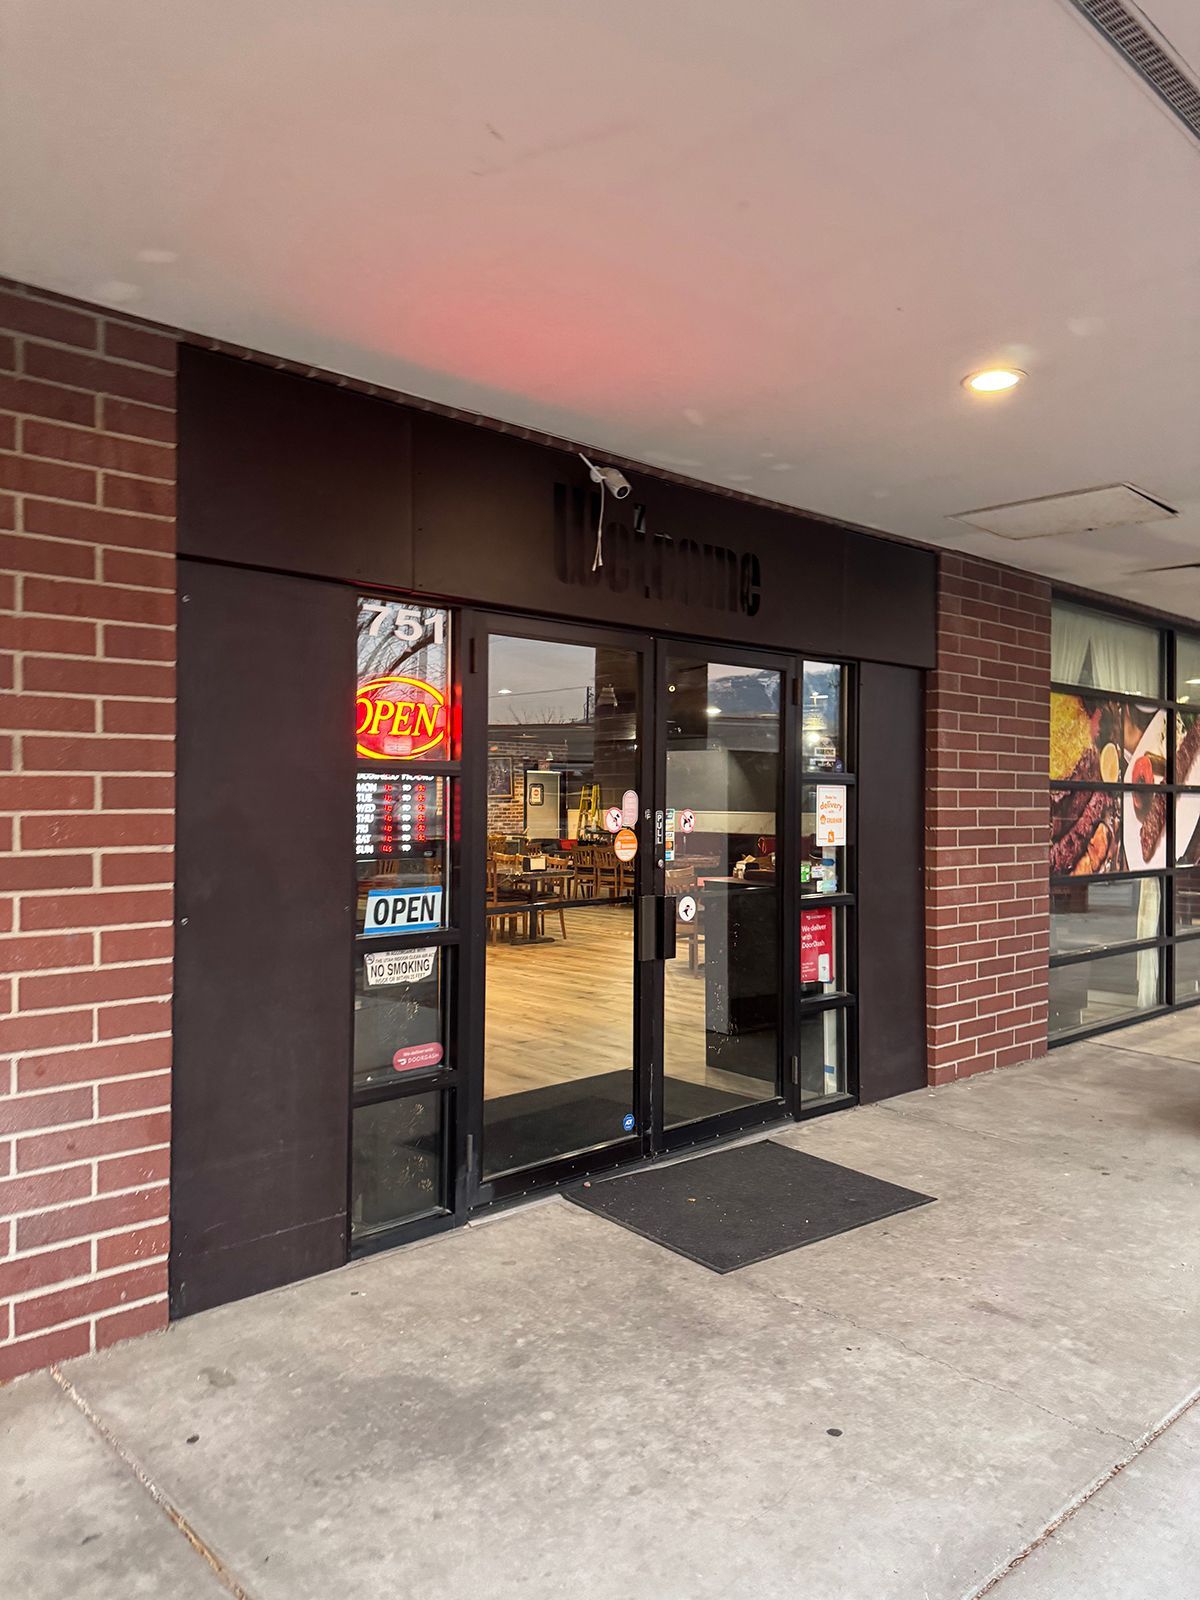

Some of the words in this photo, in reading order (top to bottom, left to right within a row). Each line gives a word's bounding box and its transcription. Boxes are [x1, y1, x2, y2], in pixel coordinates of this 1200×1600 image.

[362, 604, 444, 644] 751
[356, 699, 441, 737] OPEN
[356, 783, 377, 793] MON
[356, 793, 373, 803] TUE
[356, 803, 376, 813] WED
[820, 801, 843, 811] delivery
[356, 813, 374, 823] THU
[356, 824, 369, 834] FRI
[356, 834, 371, 844] SAT
[356, 845, 374, 855] SUN
[373, 895, 436, 926] OPEN
[802, 940, 825, 948] DoorDash
[371, 964, 385, 978] NO
[387, 959, 430, 976] SMOKING
